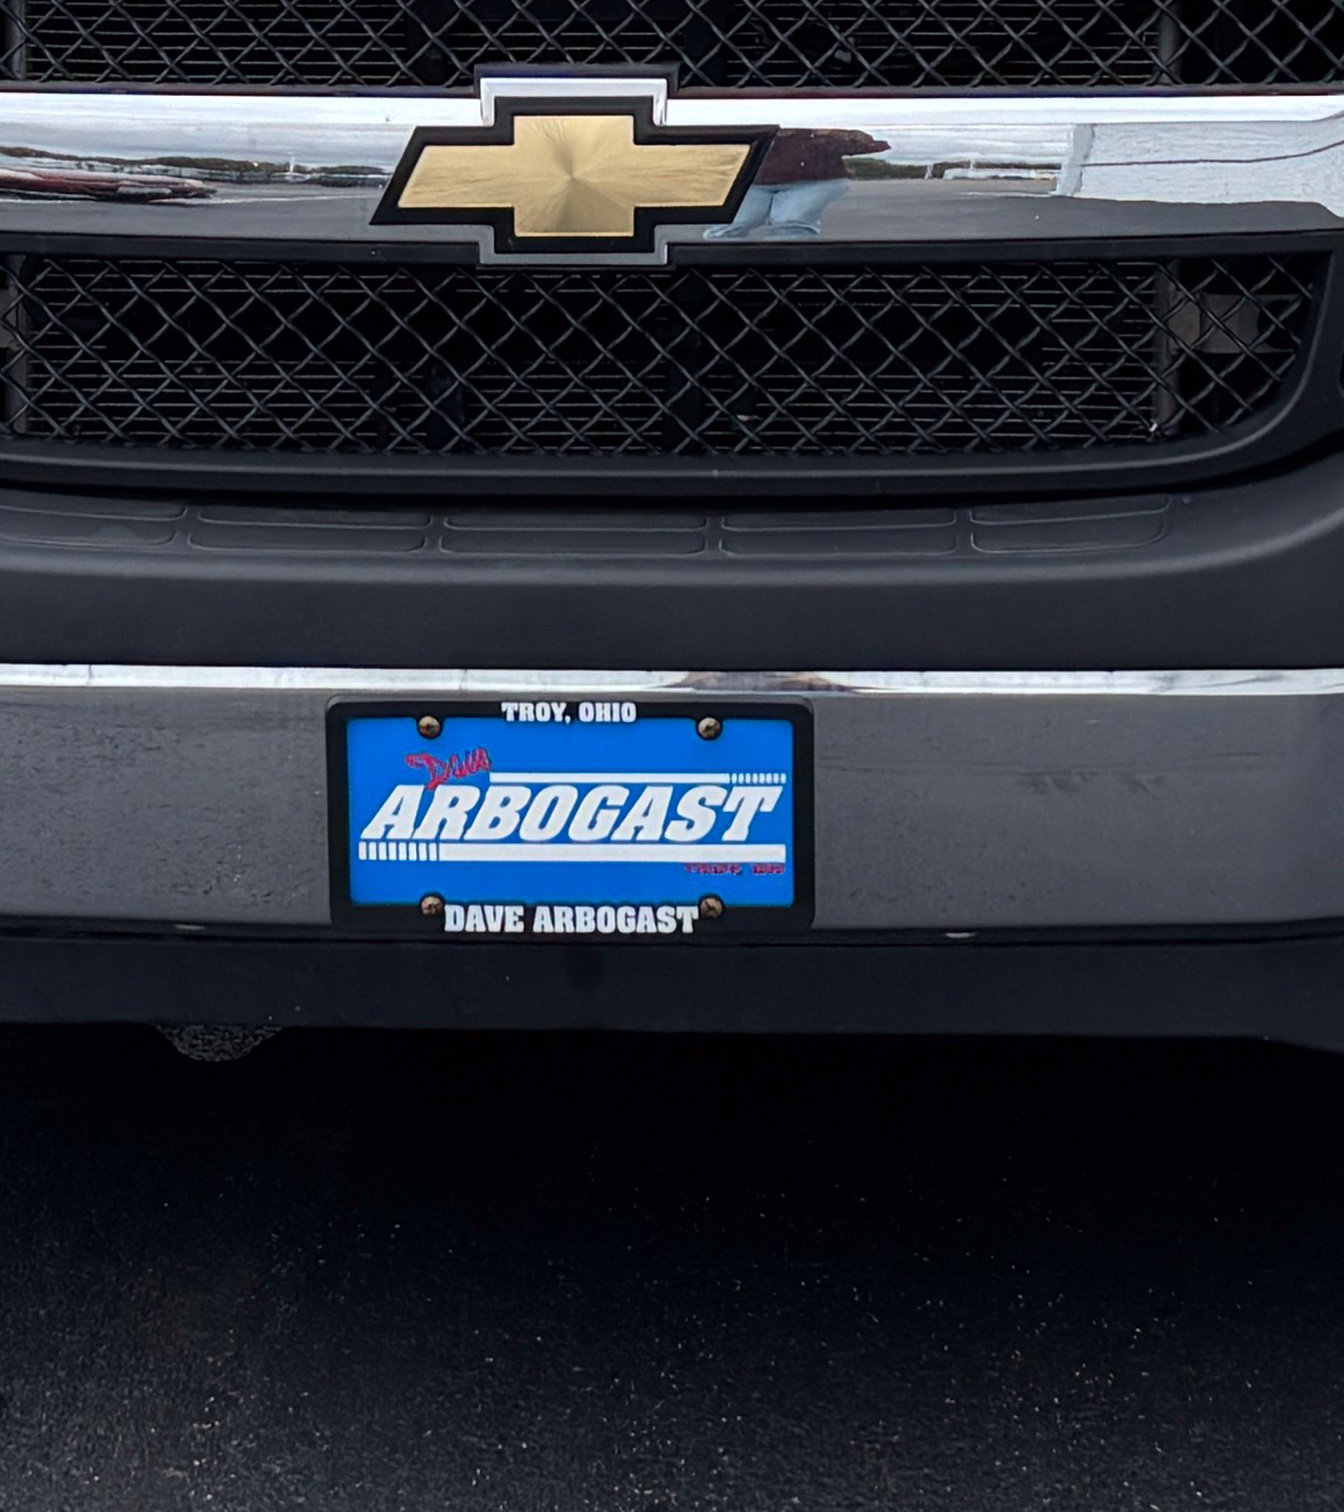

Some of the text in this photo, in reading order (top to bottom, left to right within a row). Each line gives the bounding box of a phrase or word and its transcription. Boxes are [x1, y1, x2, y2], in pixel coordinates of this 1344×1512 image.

[501, 701, 638, 725] TROY, OHIO
[359, 783, 784, 843] ARBOGAST
[443, 904, 700, 935] DAVE ARBOGAST
